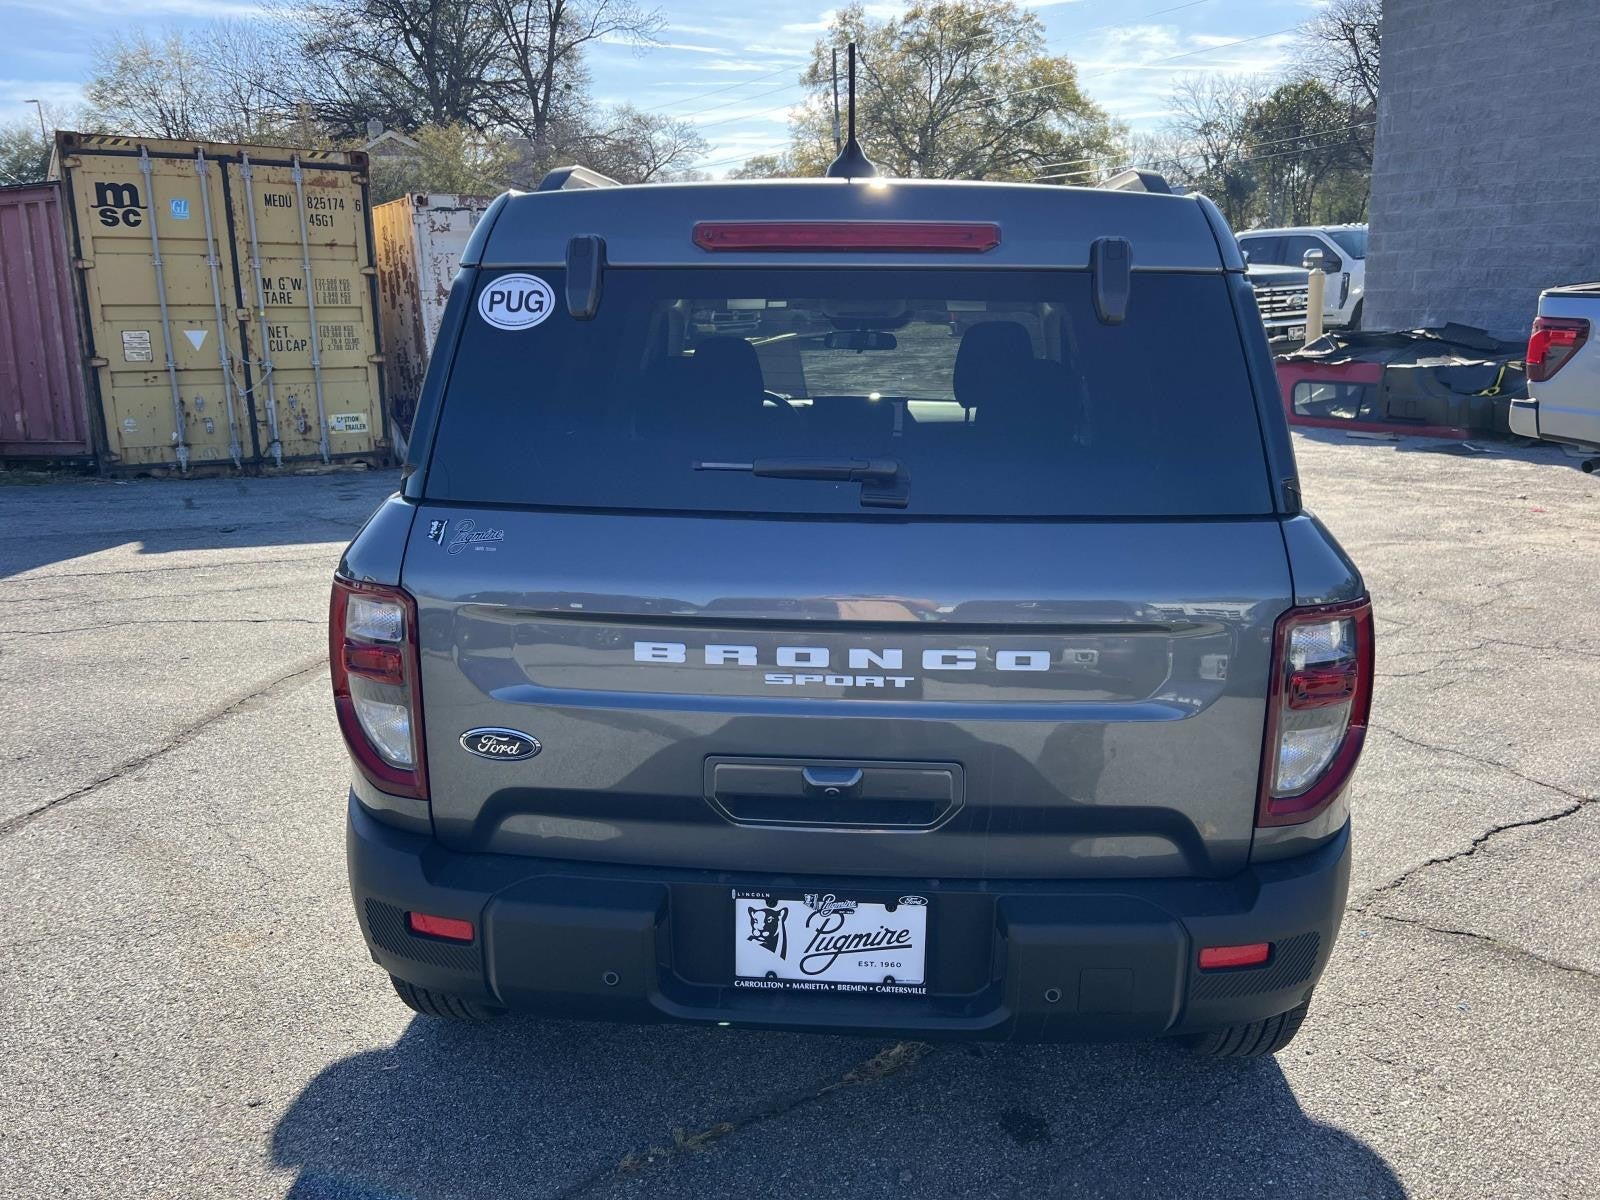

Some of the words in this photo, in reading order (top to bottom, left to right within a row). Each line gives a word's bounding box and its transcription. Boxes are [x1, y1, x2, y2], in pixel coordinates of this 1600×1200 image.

[264, 193, 292, 208] MEDU
[307, 196, 344, 211] 825174
[355, 199, 361, 212] 6
[309, 213, 334, 227] 45G1
[264, 292, 293, 305] TARE
[488, 289, 545, 313] PUG
[268, 326, 289, 339] NET
[634, 641, 1051, 671] BRONCO
[764, 673, 914, 688] SPORT
[477, 734, 520, 755] Ford
[799, 910, 913, 976] Pugmire
[858, 960, 877, 968] EST.
[734, 980, 784, 989] CARROLLTON
[792, 983, 829, 991] MARIETTA
[837, 984, 868, 992] BREMEN
[875, 985, 927, 995] CARTERSVILLE
